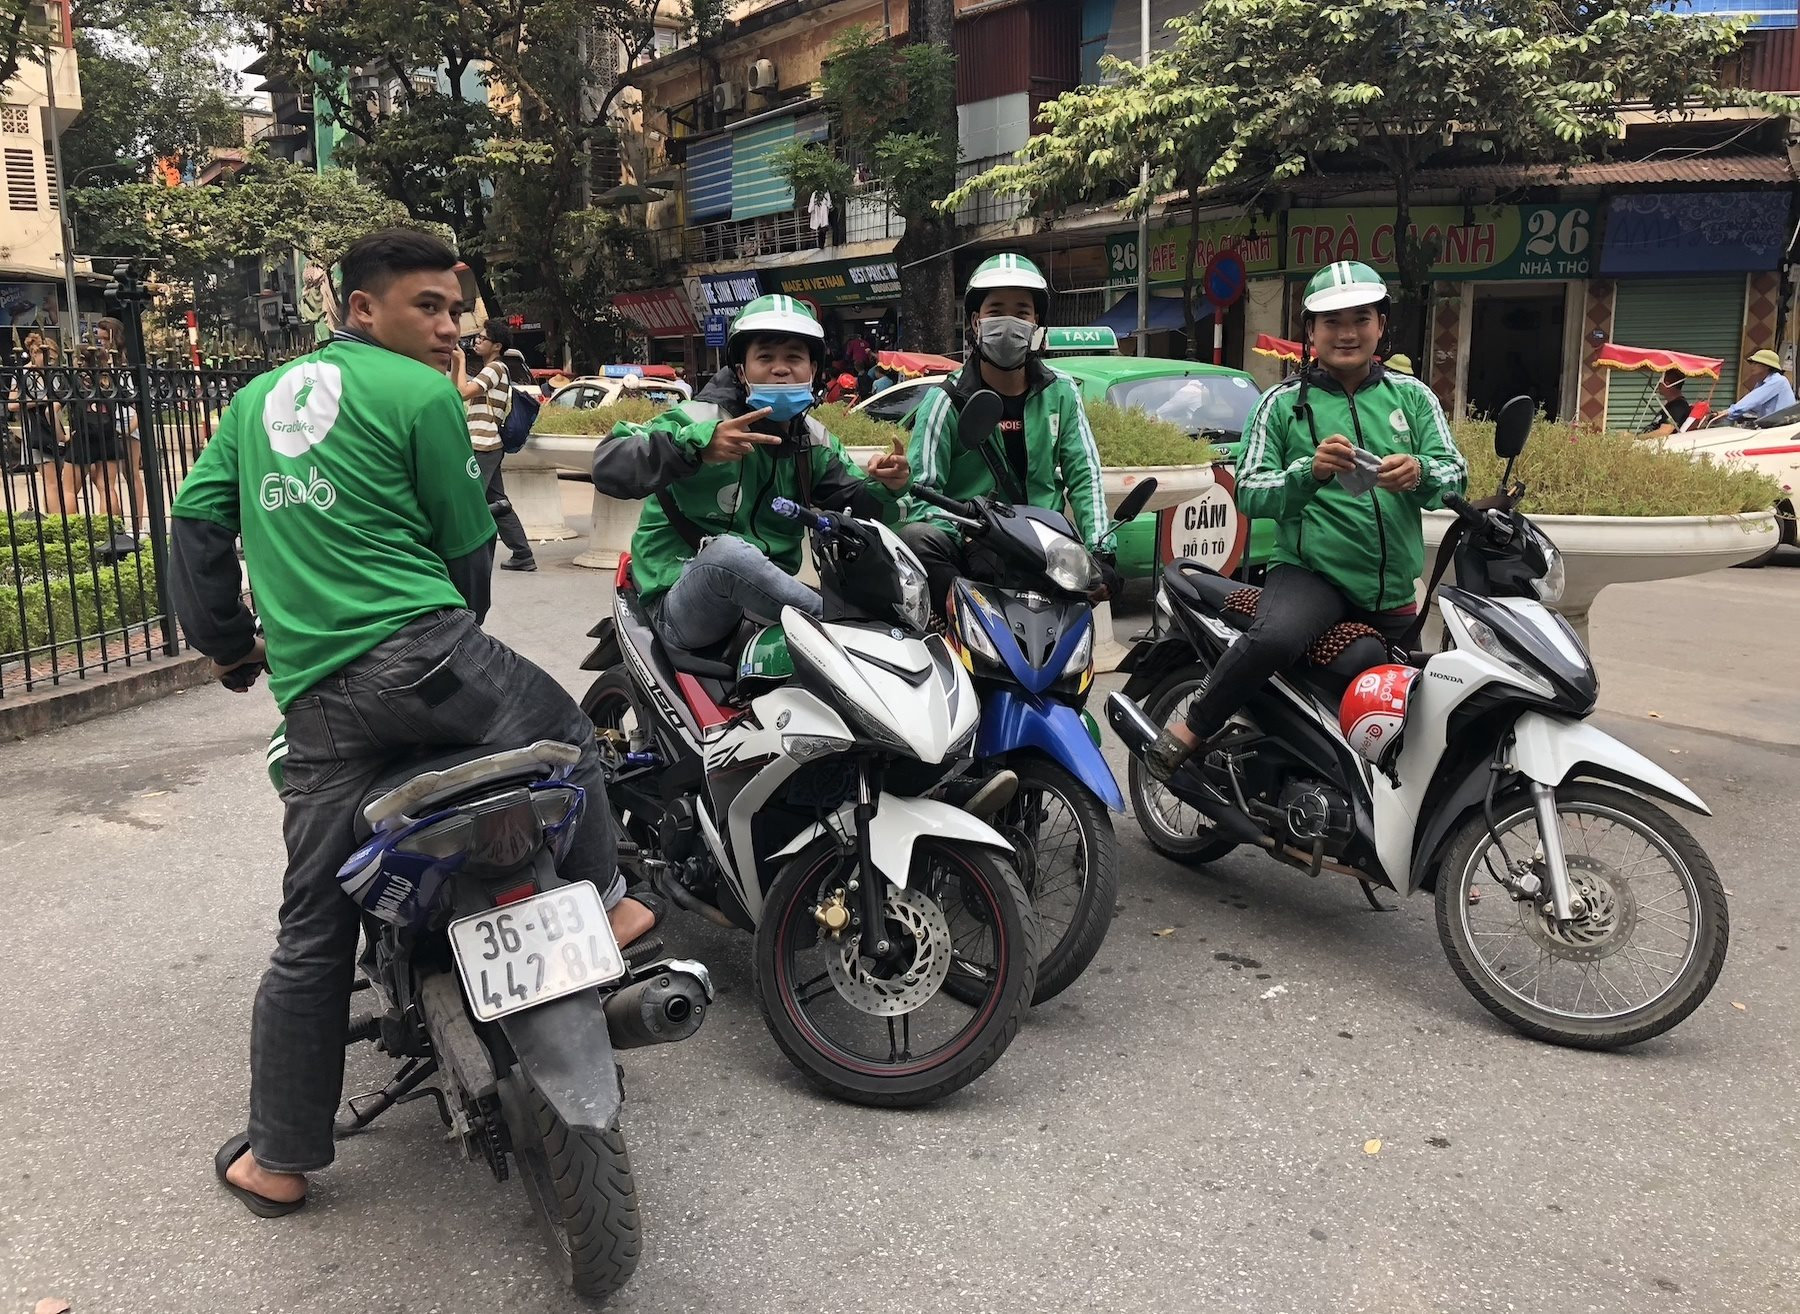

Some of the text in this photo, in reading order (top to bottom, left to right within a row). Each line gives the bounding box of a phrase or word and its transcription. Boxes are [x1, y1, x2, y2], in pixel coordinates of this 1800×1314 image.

[1290, 214, 1359, 266] TRÀ
[1526, 208, 1590, 256] 26
[1111, 242, 1138, 272] 26
[1149, 234, 1177, 273] AFÉ
[1194, 230, 1217, 268] RÀ
[848, 266, 868, 284] BEST
[866, 264, 890, 283] PRICE
[1520, 257, 1590, 275] NHÀ THỜ
[701, 283, 718, 304] THE
[729, 278, 760, 301] TOURIST
[781, 279, 805, 293] MADE
[810, 275, 846, 290] VIETNAM
[1111, 274, 1138, 286] NHÀ TH
[1062, 331, 1101, 342] TAXI
[260, 466, 337, 512] Grab
[1184, 496, 1227, 531] CẤM
[1183, 538, 1225, 558] ĐỖ Ô TÔ
[1429, 671, 1464, 685] HONDA
[475, 895, 584, 960] 36-B3
